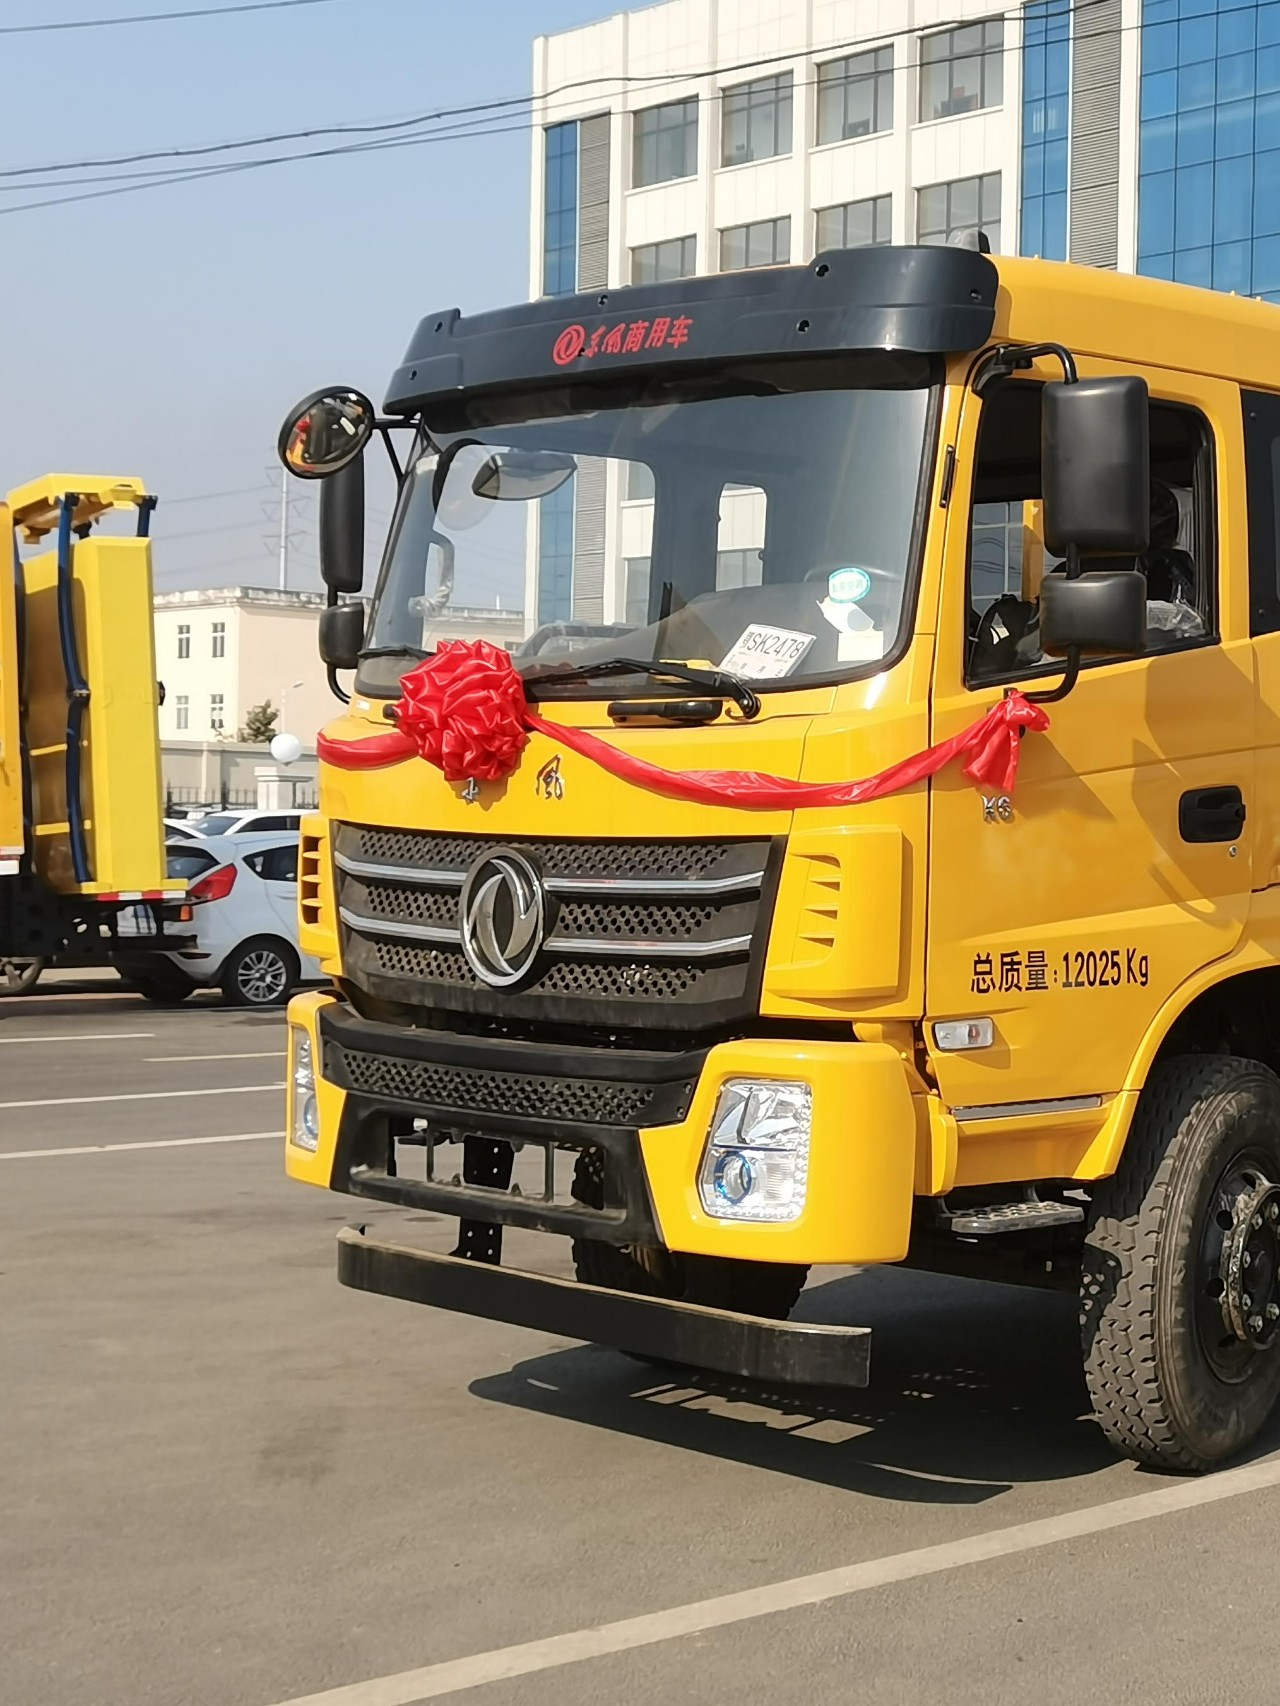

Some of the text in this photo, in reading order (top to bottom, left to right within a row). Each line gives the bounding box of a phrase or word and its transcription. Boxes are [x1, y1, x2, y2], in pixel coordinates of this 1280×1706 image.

[584, 315, 693, 358] 东风商用车
